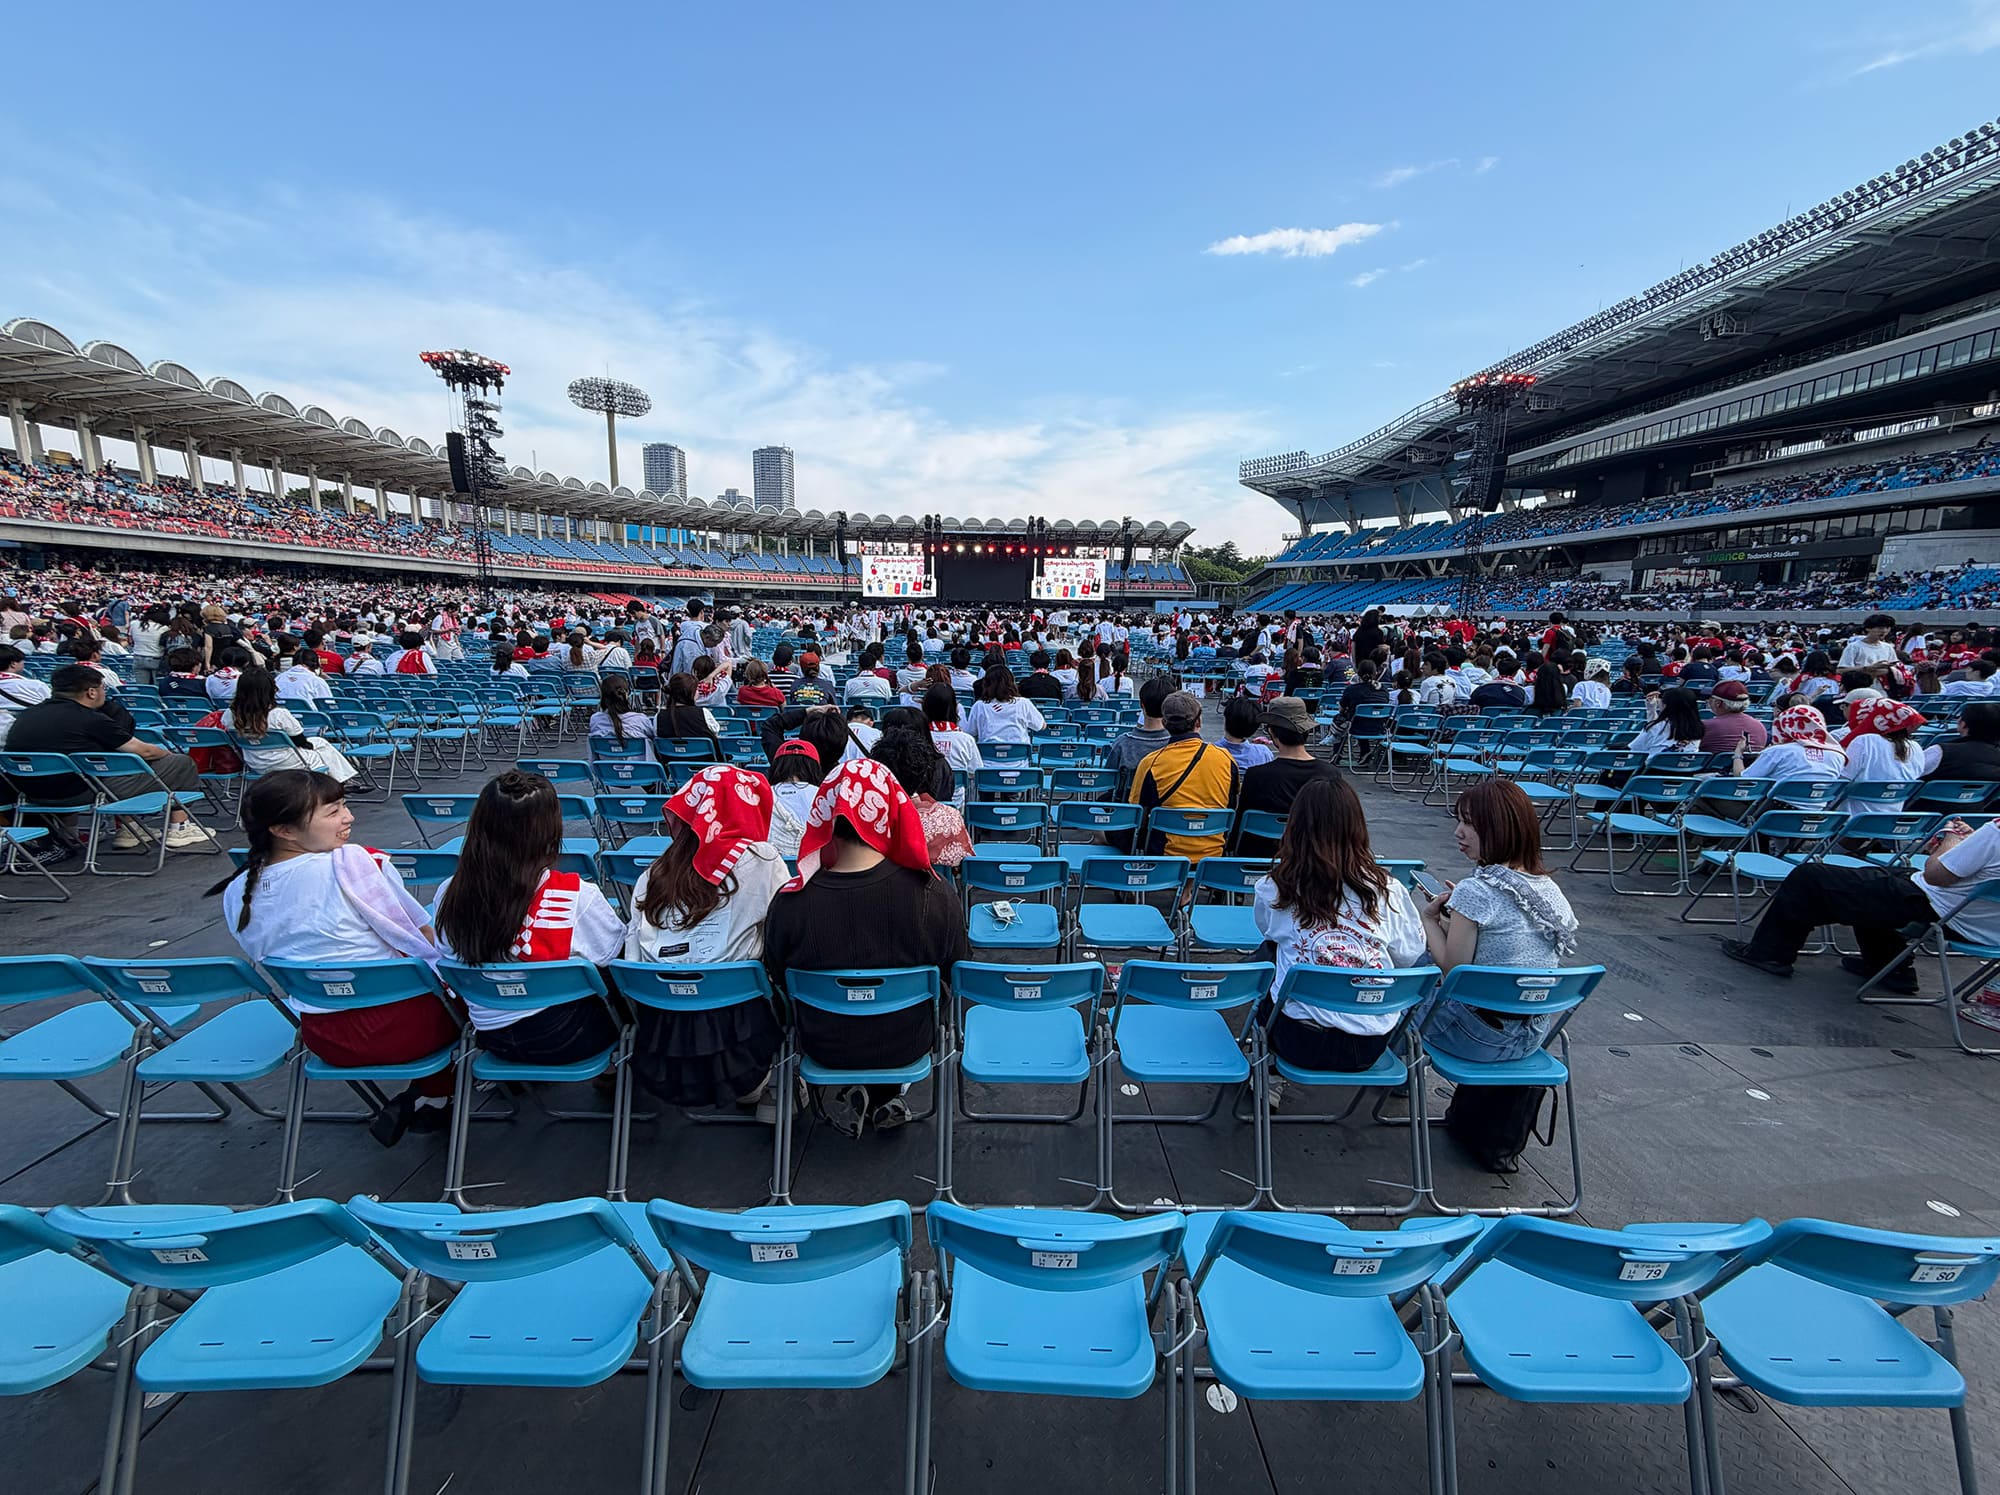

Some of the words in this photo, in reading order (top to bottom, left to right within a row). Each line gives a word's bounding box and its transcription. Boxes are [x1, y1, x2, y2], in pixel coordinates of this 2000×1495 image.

[1773, 550, 1799, 558] Stadium
[1309, 925, 1328, 938] CANDY
[179, 1253, 201, 1261] 74
[472, 1248, 490, 1258] 75
[776, 1249, 794, 1259] 76
[1056, 1259, 1073, 1267] 77
[1359, 1265, 1375, 1273] 78
[1645, 1269, 1662, 1278] 79
[1936, 1272, 1955, 1281] 80
